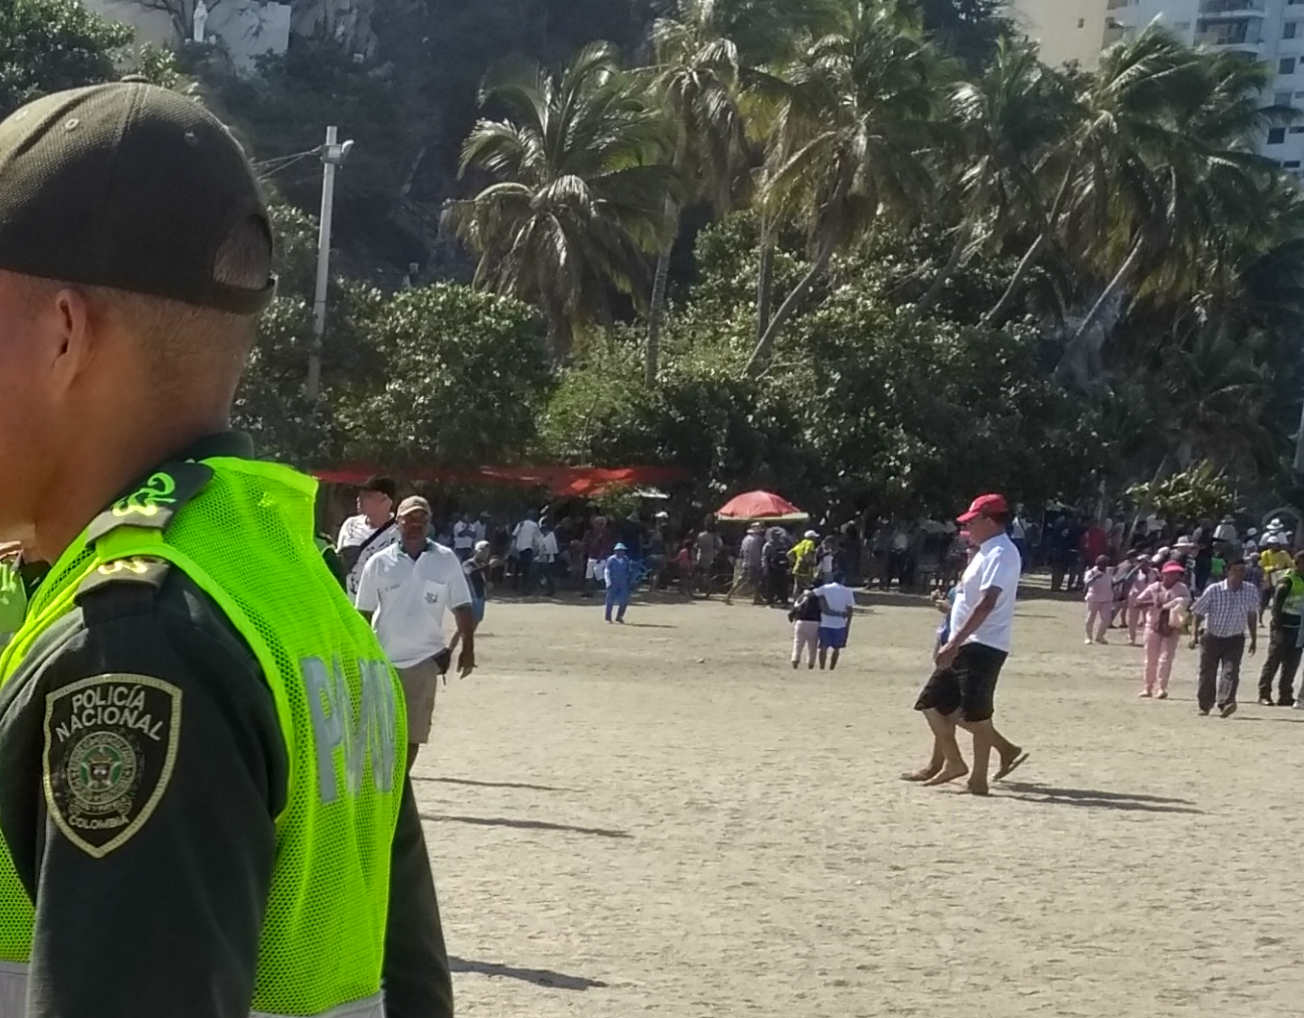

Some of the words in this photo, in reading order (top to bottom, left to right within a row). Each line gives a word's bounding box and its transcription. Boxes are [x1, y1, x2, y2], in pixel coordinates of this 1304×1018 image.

[72, 685, 145, 713] POLICÍA
[55, 707, 163, 742] NACIONAL
[68, 814, 130, 830] COLOMBIA
